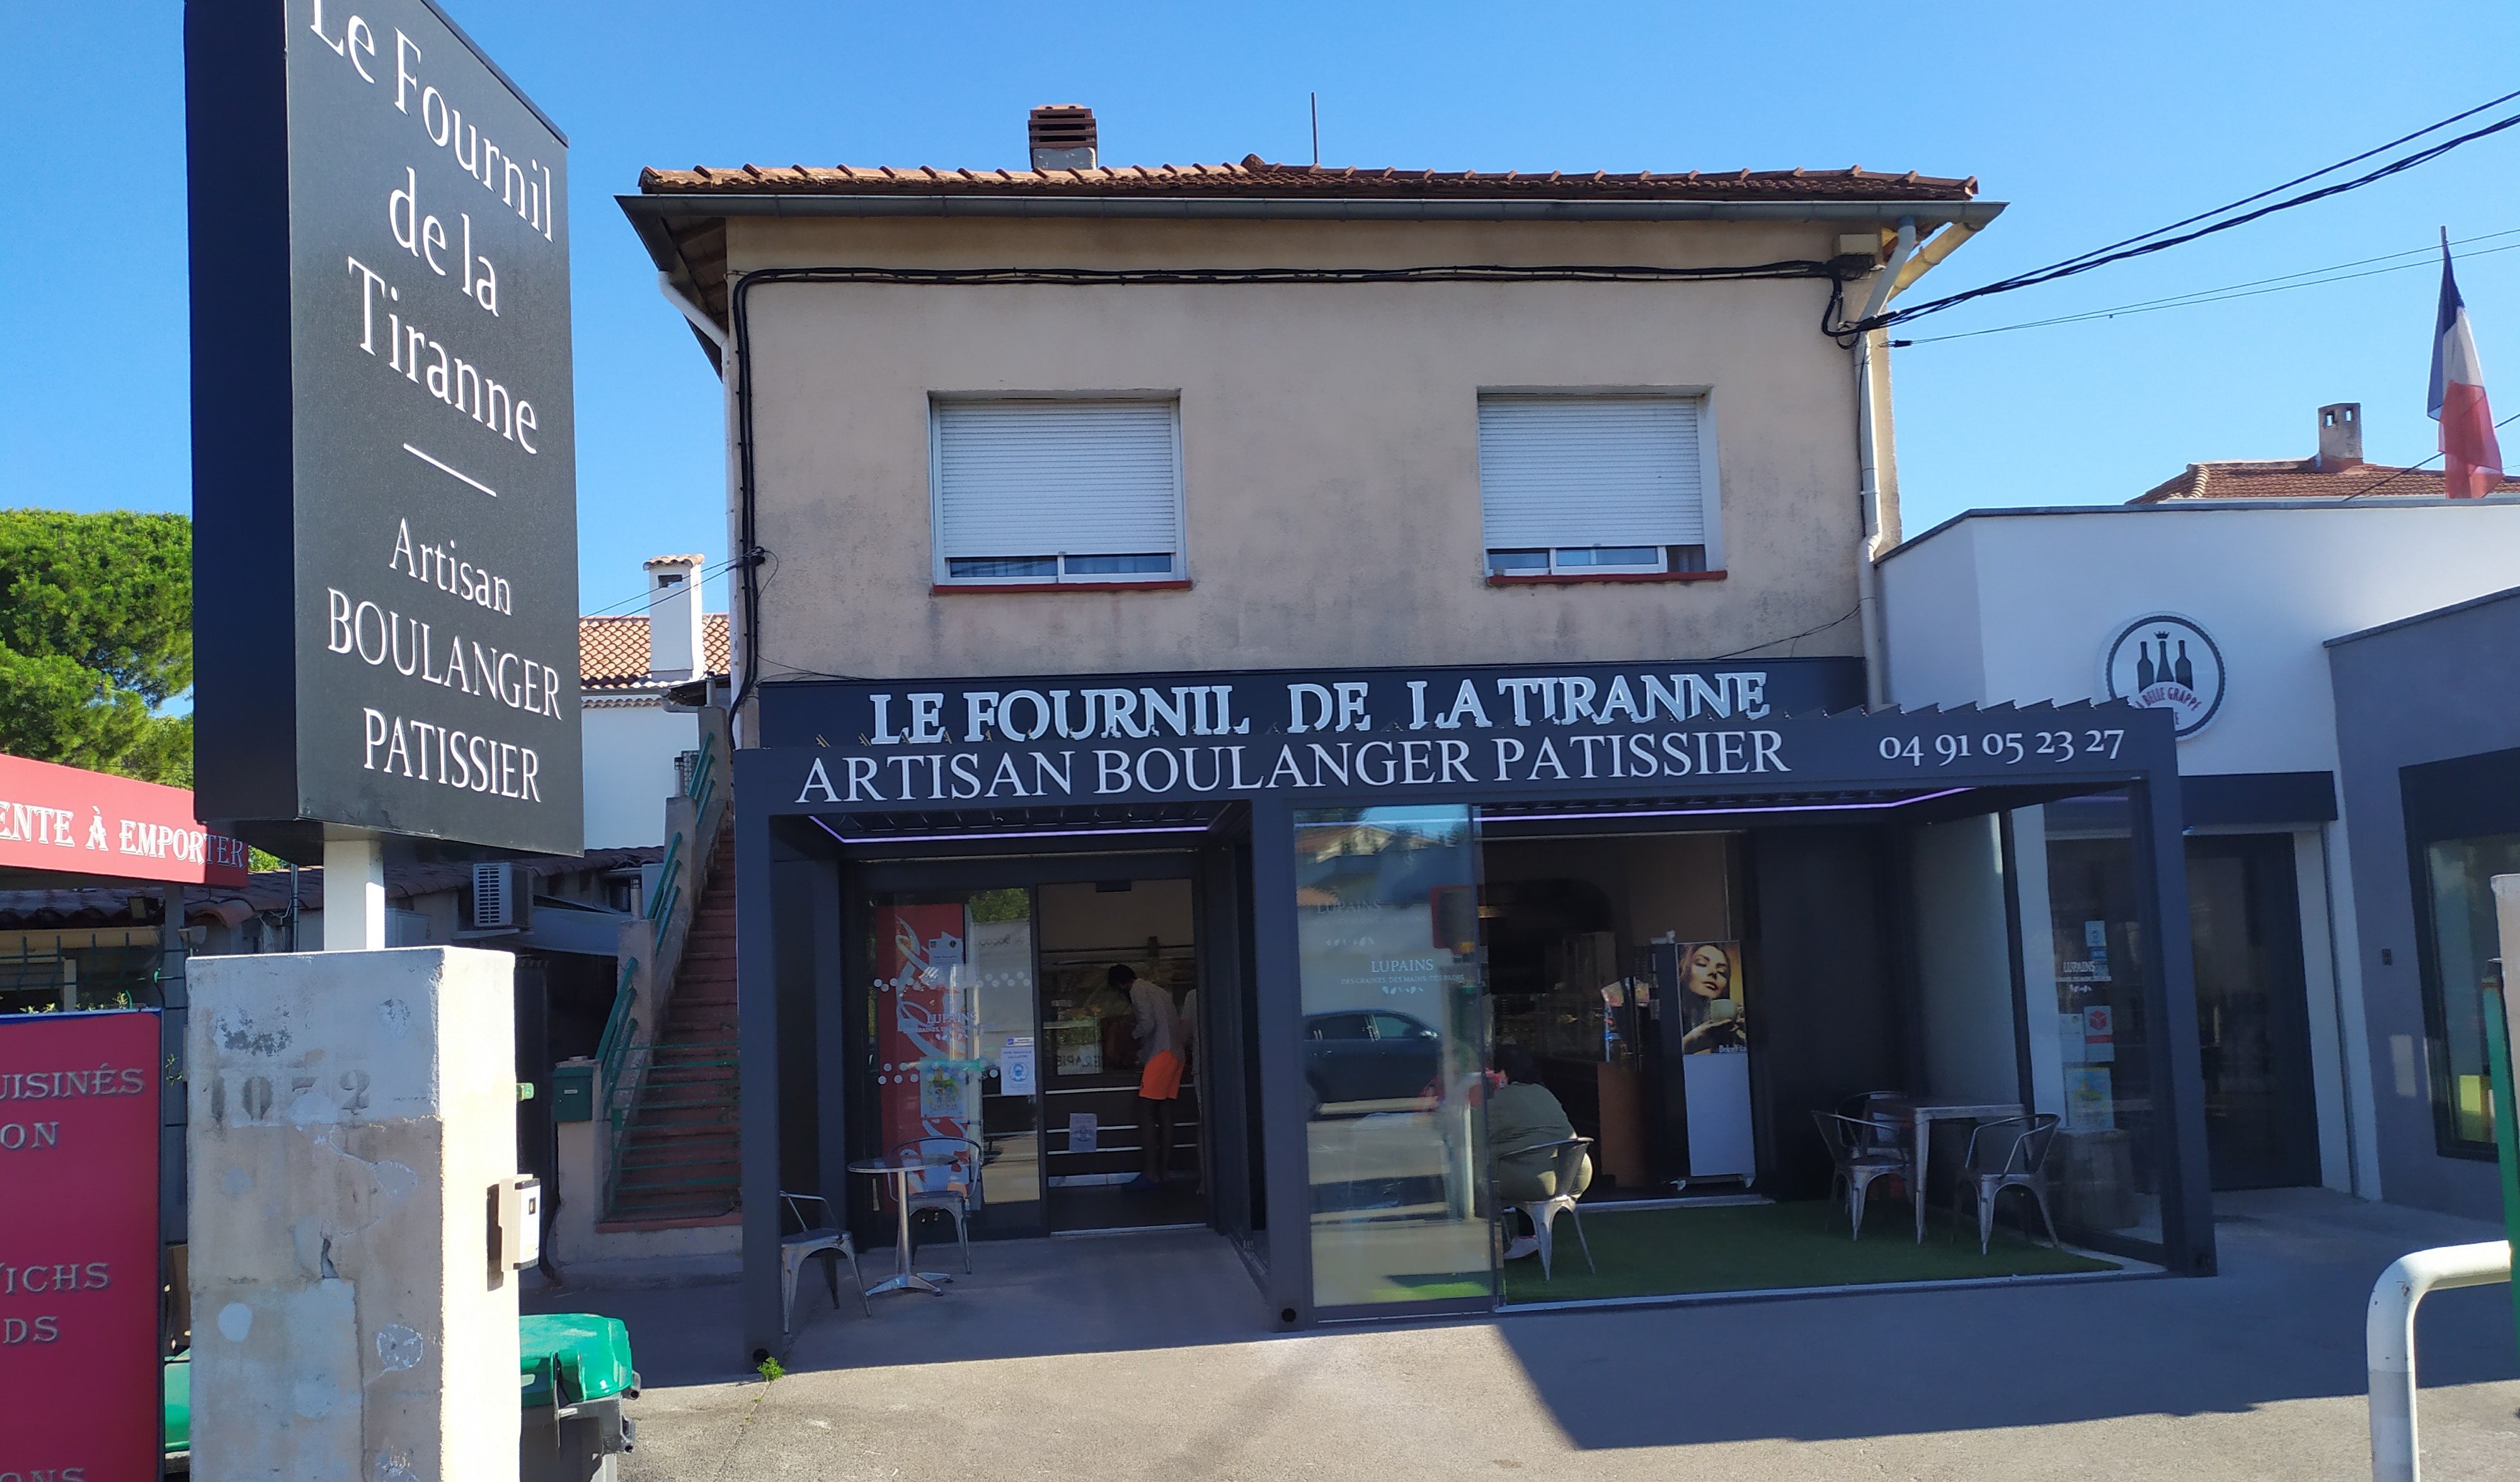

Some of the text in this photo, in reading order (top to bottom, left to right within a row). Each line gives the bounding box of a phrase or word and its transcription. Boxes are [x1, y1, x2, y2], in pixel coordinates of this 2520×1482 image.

[394, 26, 554, 242] Fournil
[389, 167, 499, 316] de la
[348, 256, 537, 454] Tiranne
[389, 517, 512, 616] Artisan
[327, 587, 562, 721] BOULANGER
[869, 671, 1771, 745] LE FOURNIL DE LA TIRANNE
[2141, 687, 2165, 706] BELLE
[2167, 687, 2202, 712] GRAPPE
[363, 707, 541, 803] PATISSIER
[795, 730, 1792, 804] ARTISAN BOULANGER PATISSIER
[1879, 729, 2125, 767] 04 91 05 23 27
[85, 806, 108, 852] À
[119, 819, 244, 869] EMPORTER
[1371, 959, 1434, 972] LUPAINS
[927, 1012, 977, 1023] LUPAINS
[0, 1121, 60, 1149] ON
[0, 1262, 109, 1294] ICHS
[3, 1316, 59, 1344] DS
